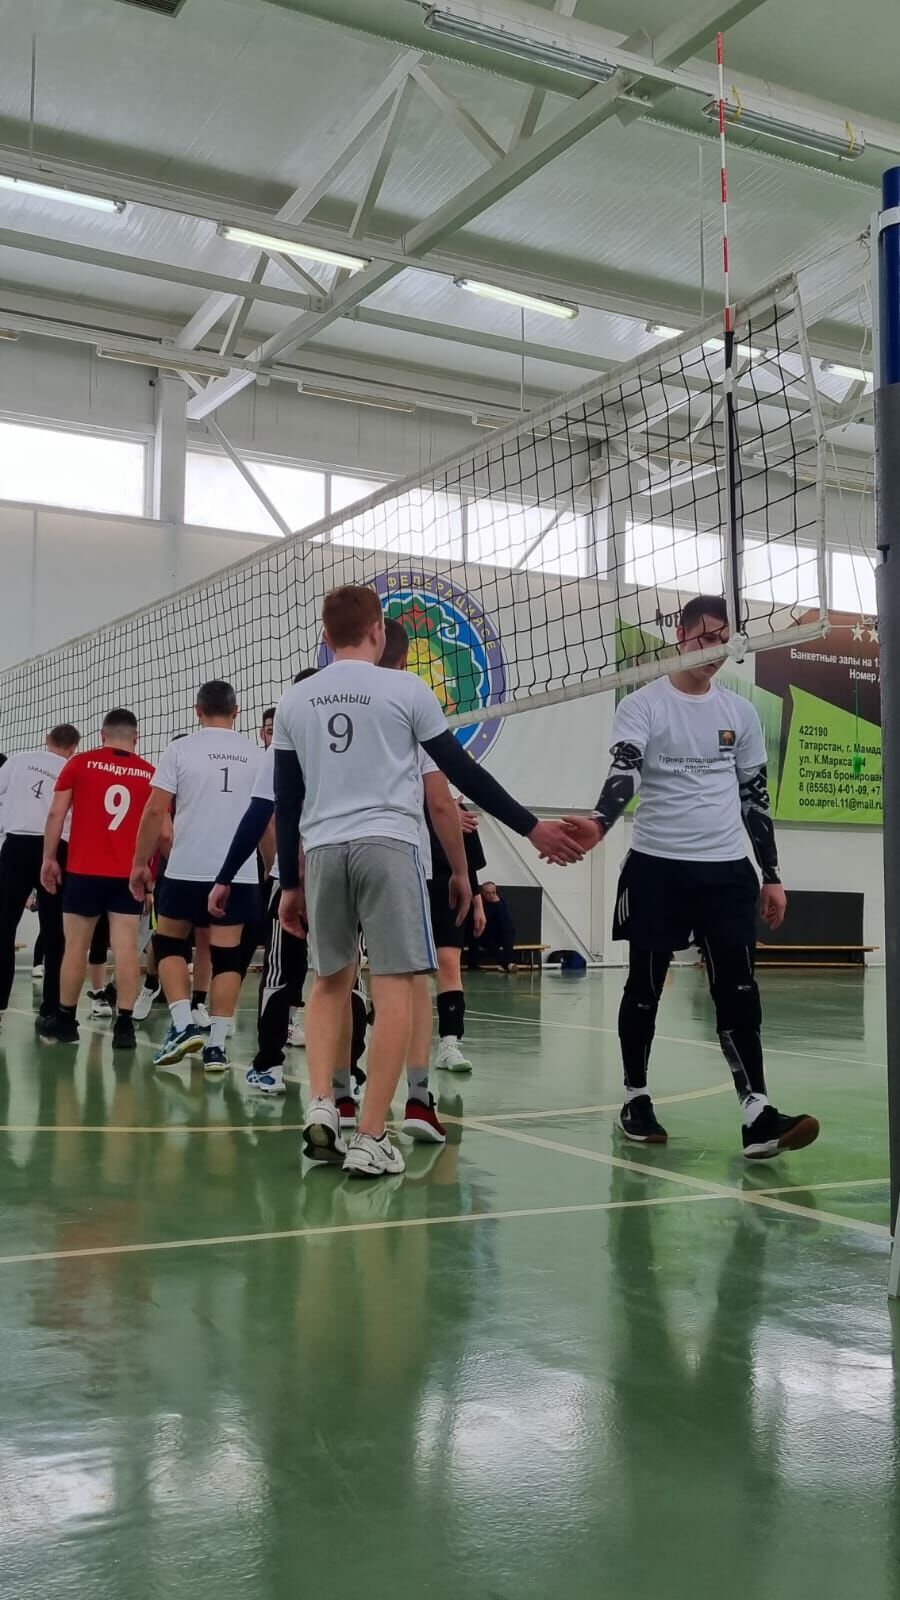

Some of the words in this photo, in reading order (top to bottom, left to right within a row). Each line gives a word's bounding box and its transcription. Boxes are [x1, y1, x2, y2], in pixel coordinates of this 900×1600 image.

[790, 648, 837, 664] Банкетные
[838, 655, 861, 666] залы
[862, 658, 873, 667] на
[849, 668, 876, 683] Номер
[309, 693, 371, 708] ТАКАНЫШ
[327, 712, 354, 754] 9
[799, 725, 828, 737] 422190
[799, 739, 845, 753] Татарстан,
[853, 743, 882, 756] Мамад
[208, 753, 248, 763] ТАКАНЫШ
[799, 755, 812, 766] ул.
[87, 760, 152, 779] ГУБАЙДУЛЛИН
[799, 768, 832, 780] Служба
[220, 767, 232, 793] 1
[31, 780, 44, 800] 4
[799, 782, 804, 791] 8
[806, 782, 836, 796] (85563)
[104, 784, 131, 831] 9
